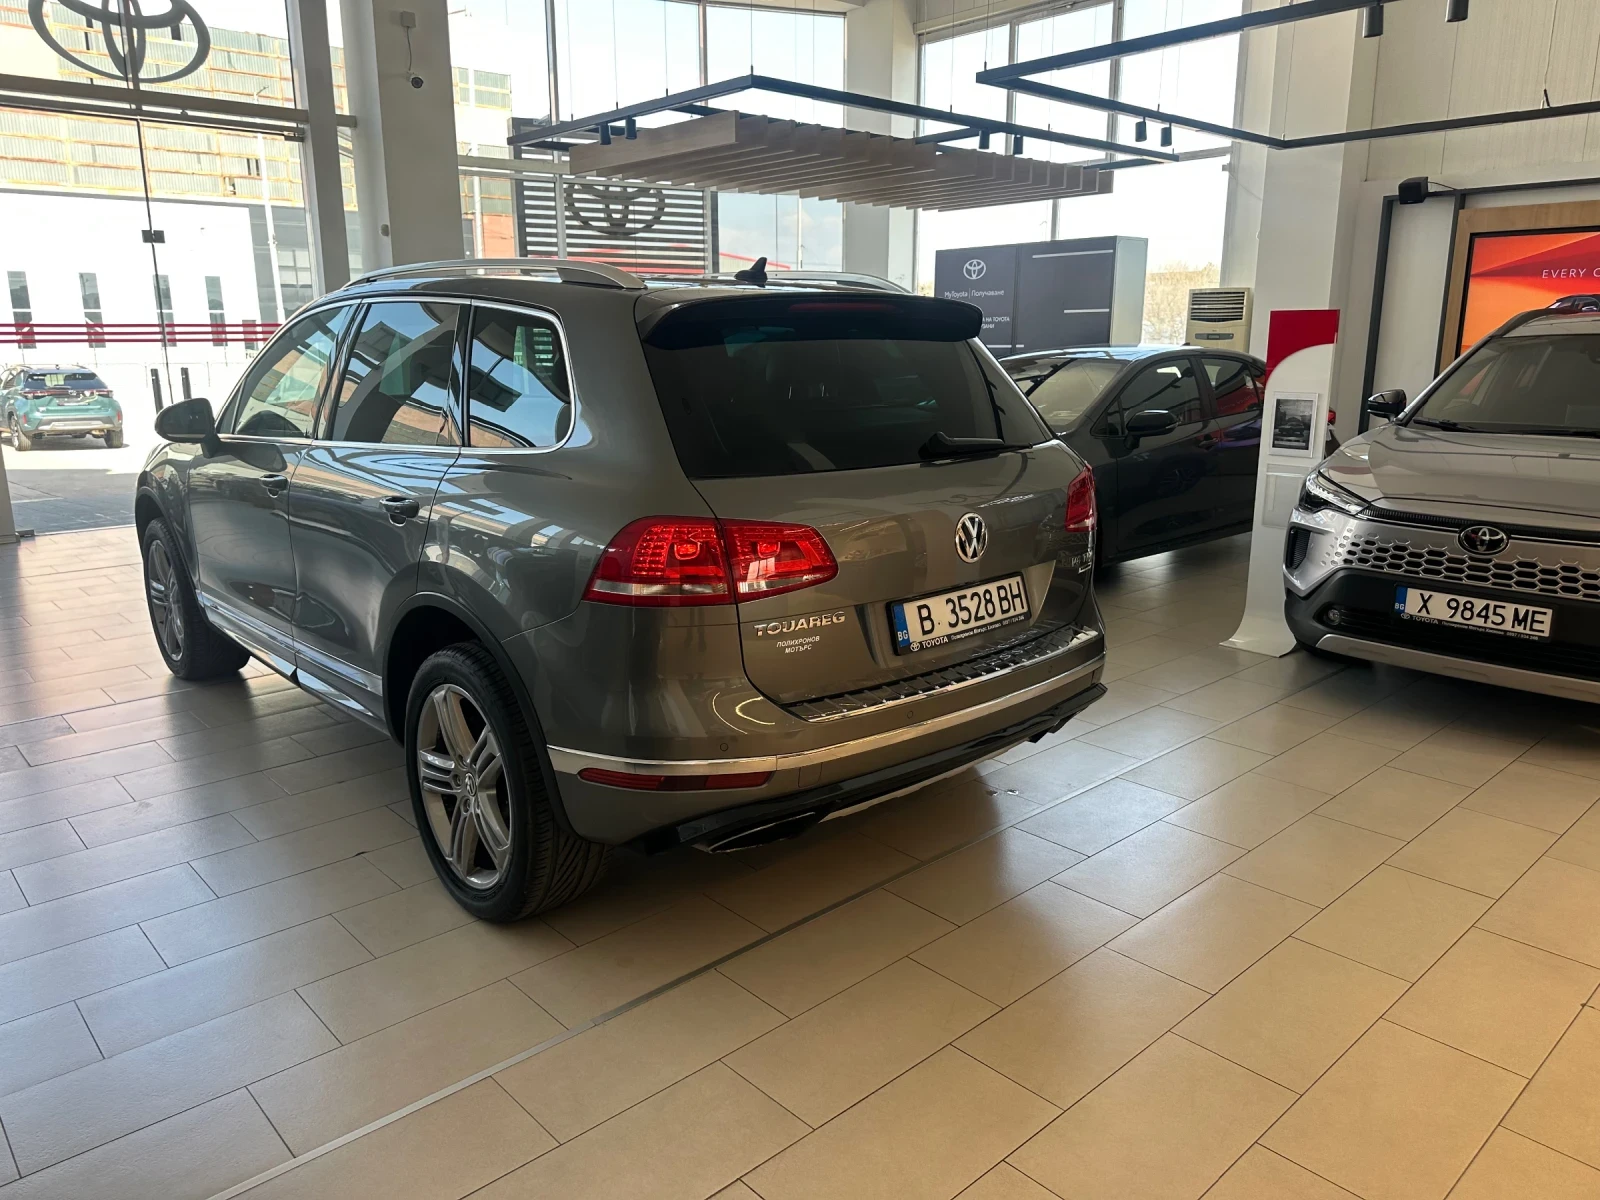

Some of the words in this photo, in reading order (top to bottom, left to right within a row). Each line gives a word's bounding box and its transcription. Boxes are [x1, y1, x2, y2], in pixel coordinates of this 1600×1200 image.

[1542, 268, 1586, 279] EVERY
[944, 291, 968, 300] MyToyota
[945, 588, 996, 628] 3528
[1394, 602, 1405, 611] BG
[1446, 597, 1506, 627] 9845
[754, 611, 846, 637] TOUAREG
[1412, 615, 1440, 625] TOYOTA
[897, 630, 908, 641] BG
[776, 635, 820, 648] ПОЛИХРОНОВ
[921, 636, 949, 649] TOYOTA
[785, 644, 812, 654] МОТЪРС
